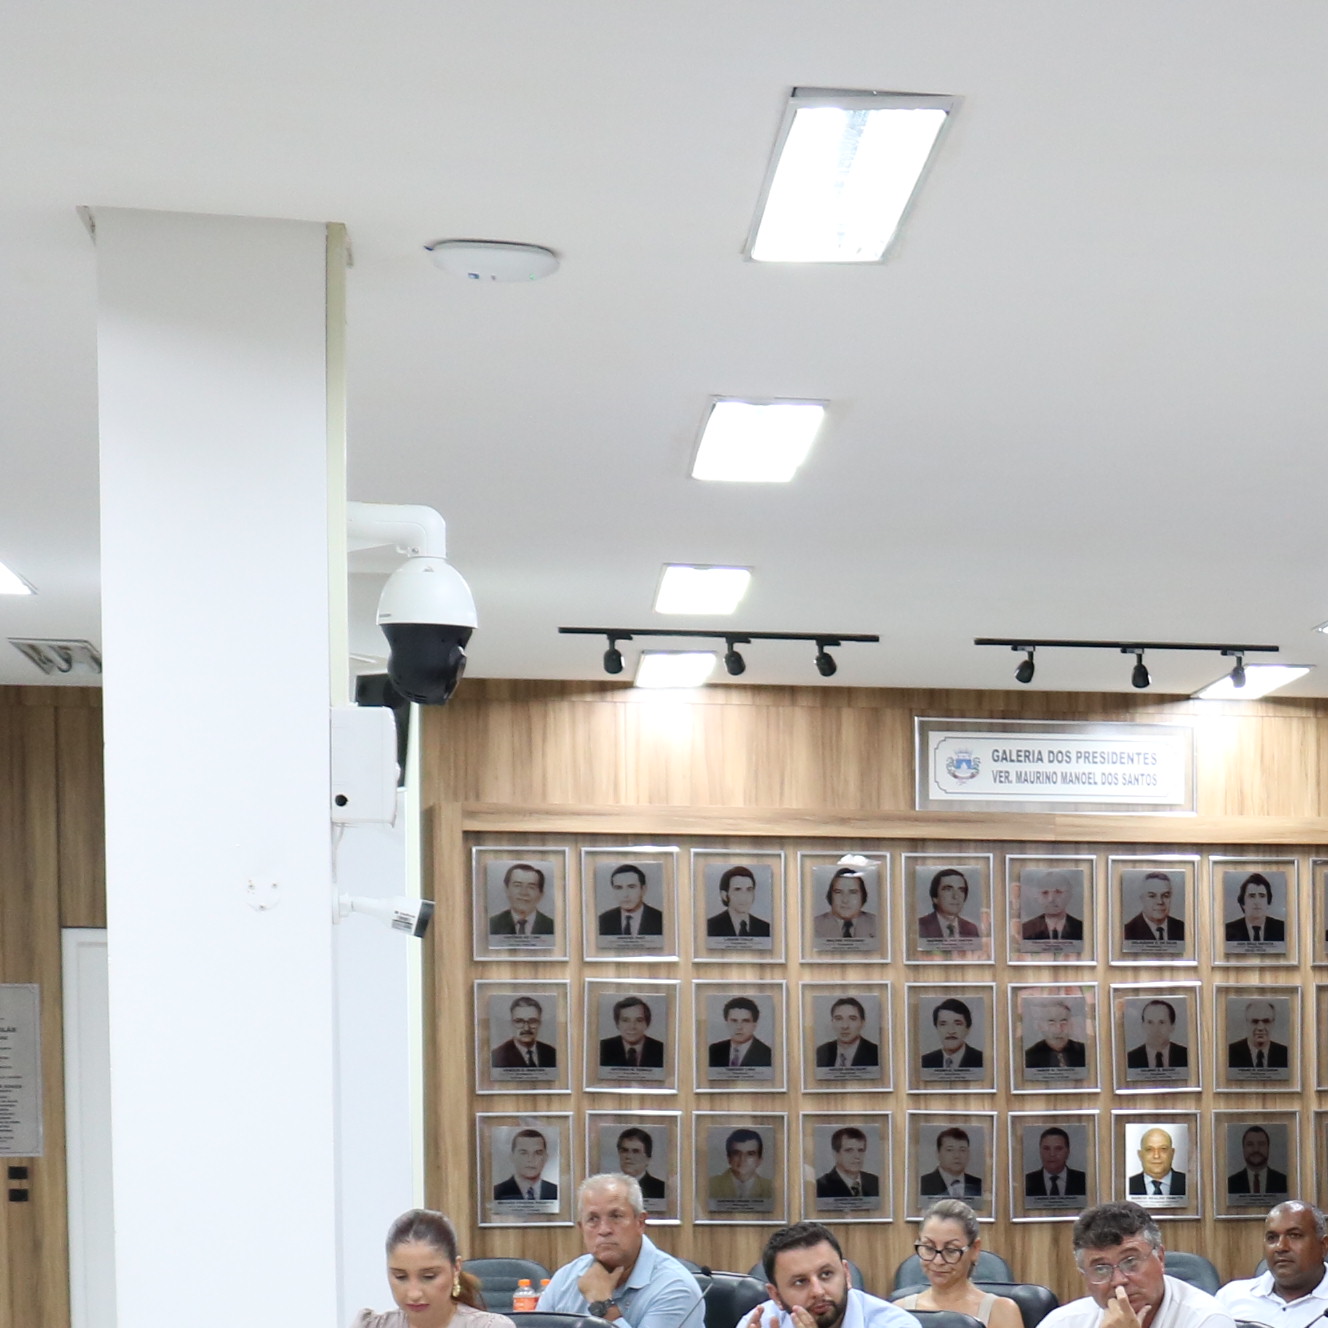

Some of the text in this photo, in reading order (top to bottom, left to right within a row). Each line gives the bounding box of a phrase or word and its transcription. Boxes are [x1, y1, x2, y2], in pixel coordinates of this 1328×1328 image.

[991, 749, 1157, 766] GALERIA DOS PRESIDENTES
[992, 769, 1157, 786] VER. MAURINO MANOEL DOS SANTOS
